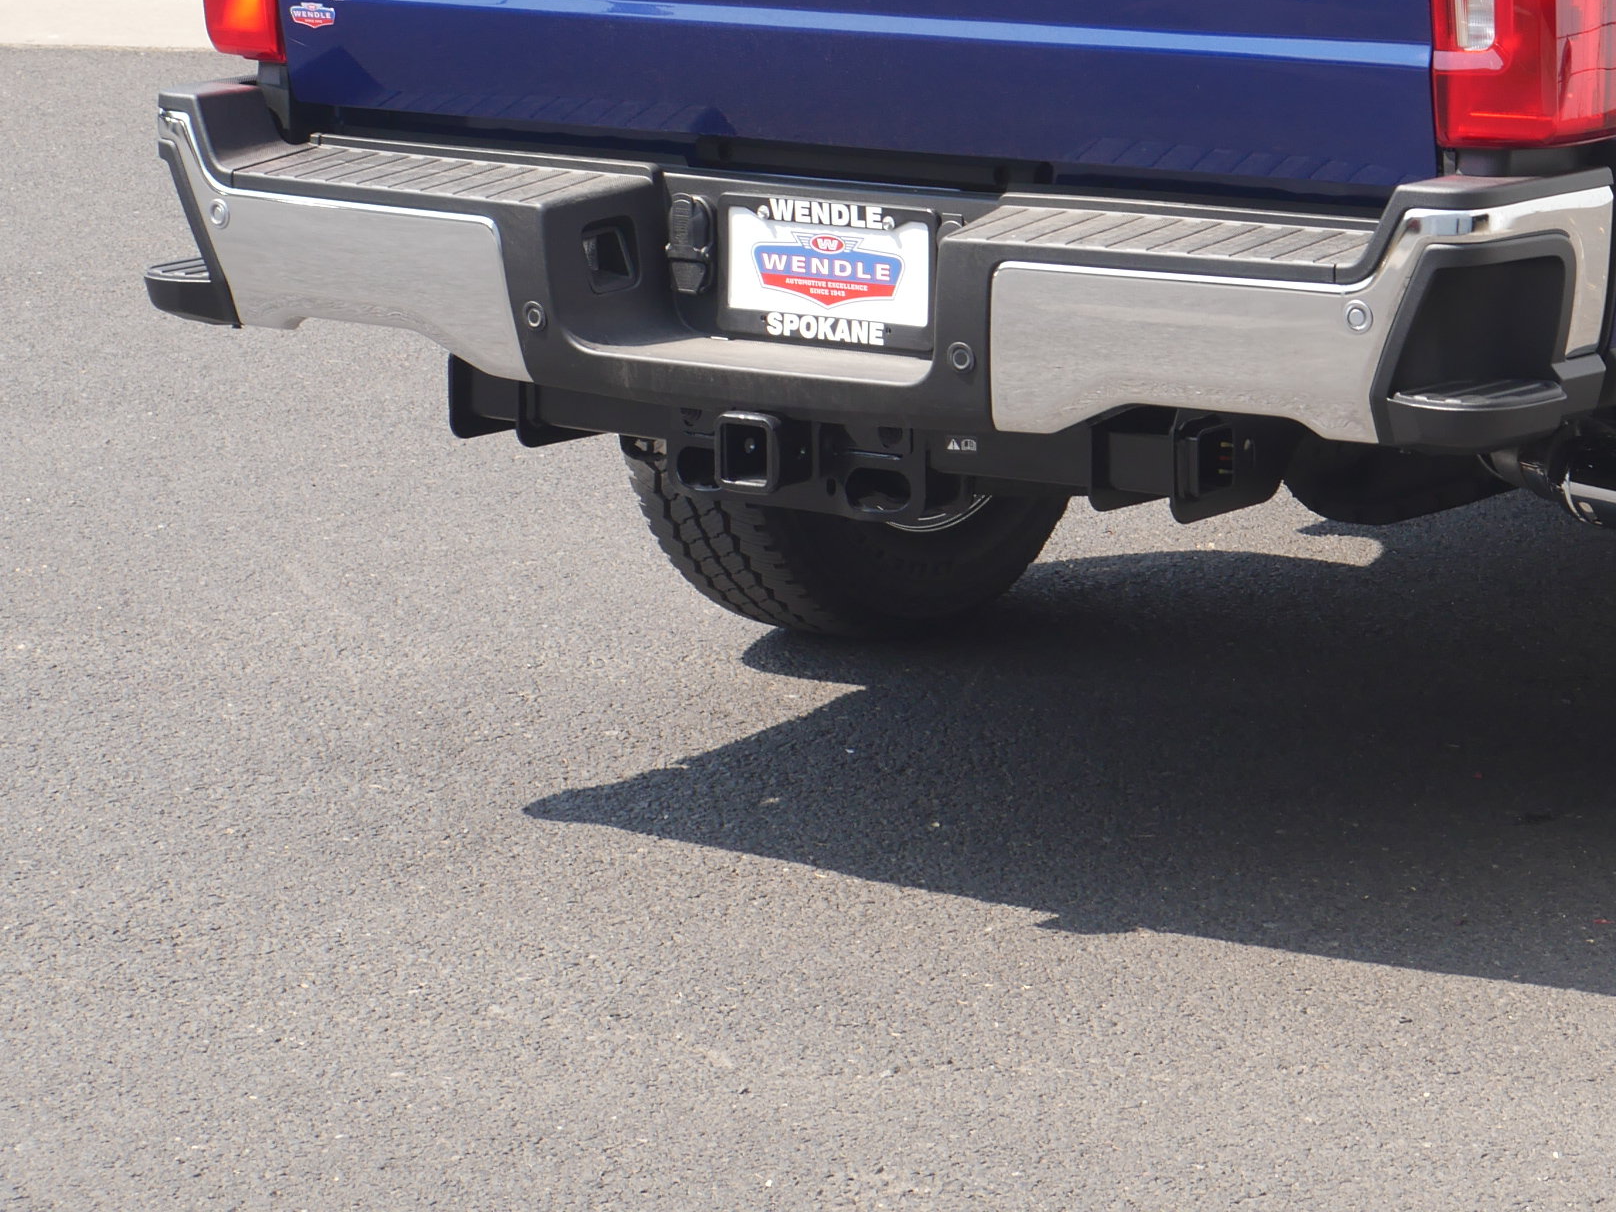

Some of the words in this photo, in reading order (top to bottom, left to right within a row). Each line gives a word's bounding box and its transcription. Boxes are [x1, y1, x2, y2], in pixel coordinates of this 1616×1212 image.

[293, 10, 331, 18] WENDLE
[769, 198, 883, 230] WENDLE
[816, 238, 839, 251] W
[762, 253, 890, 280] WENDLE
[785, 278, 827, 288] AUTOMOTIVE
[828, 281, 868, 291] EXCELLENCE
[809, 288, 830, 296] SINCE
[766, 311, 885, 346] SPOKANE
